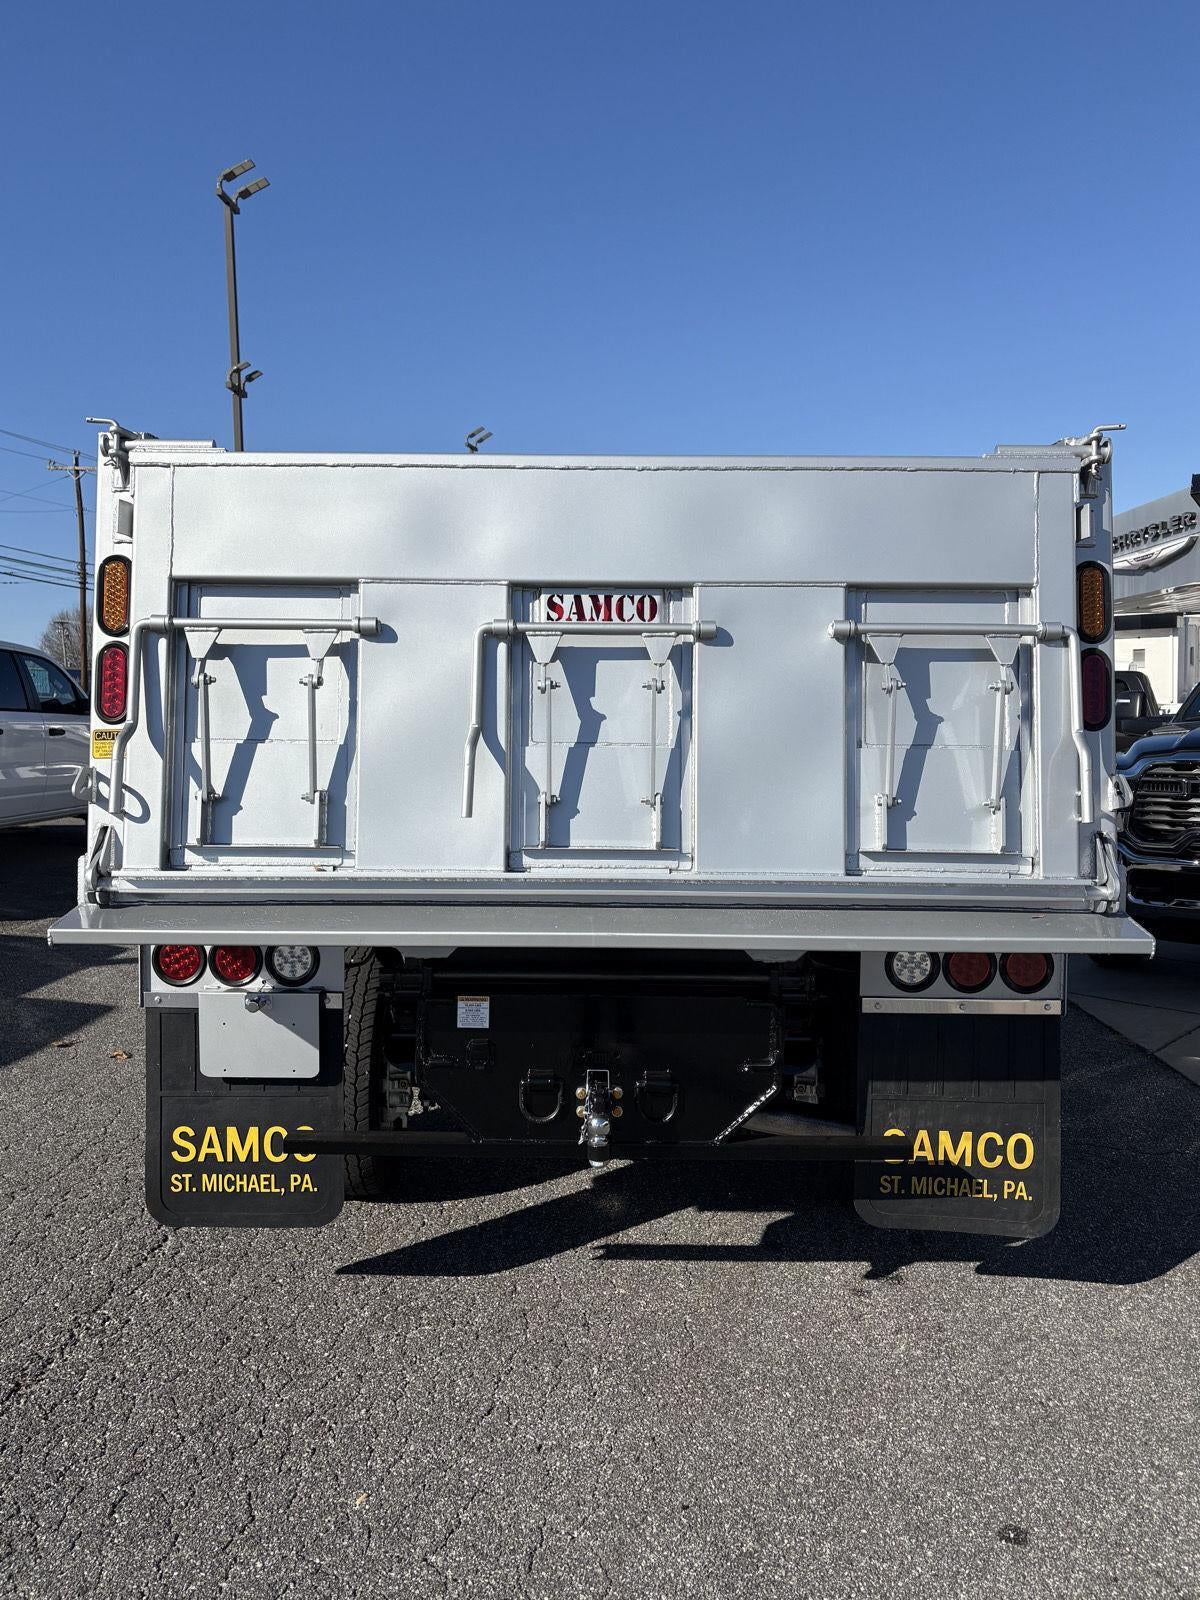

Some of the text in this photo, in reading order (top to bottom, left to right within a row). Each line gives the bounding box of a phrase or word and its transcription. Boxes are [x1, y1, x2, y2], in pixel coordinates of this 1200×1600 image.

[547, 594, 658, 622] SAMCO
[95, 731, 119, 740] CAUT
[170, 1173, 318, 1196] ST. MICHAEL, PA.
[879, 1175, 1033, 1202] ST. MICHAEL, PA.
